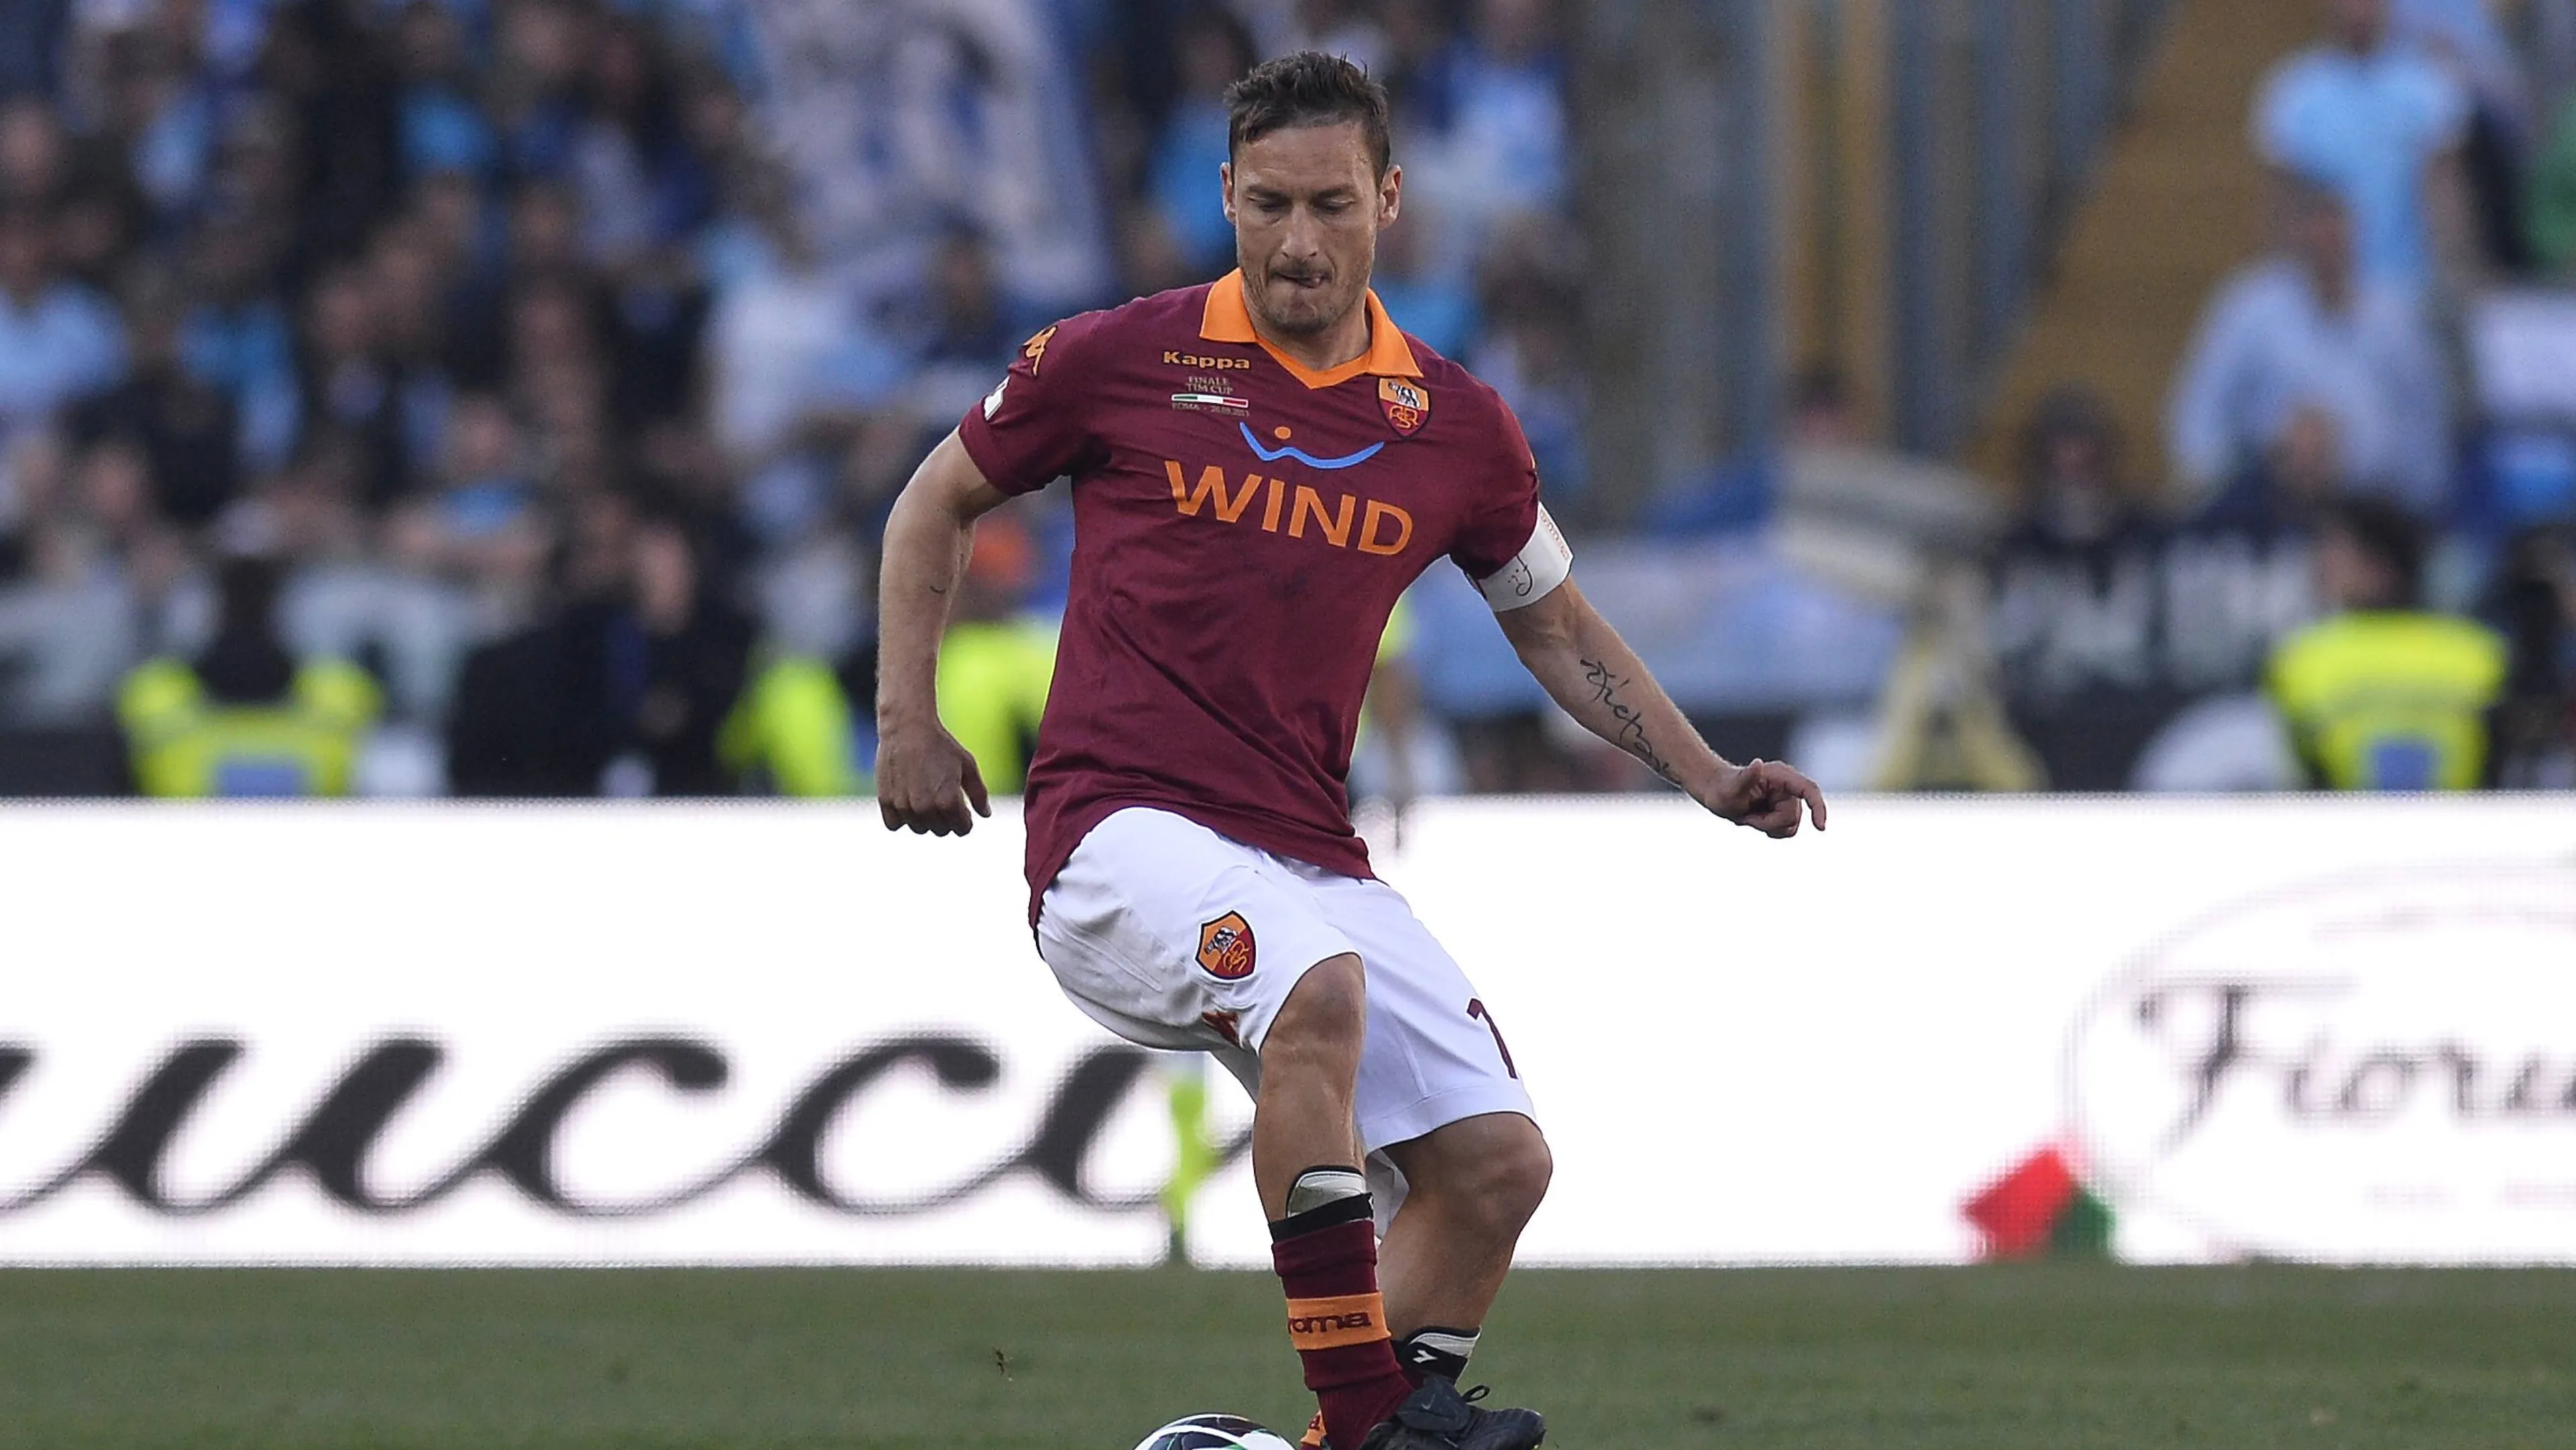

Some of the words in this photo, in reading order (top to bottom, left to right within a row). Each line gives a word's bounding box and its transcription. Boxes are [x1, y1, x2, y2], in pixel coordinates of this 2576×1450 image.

[1163, 350, 1250, 370] Kappa
[1185, 382, 1208, 393] TIM
[1210, 384, 1233, 395] CUP
[1165, 460, 1413, 556] WIND
